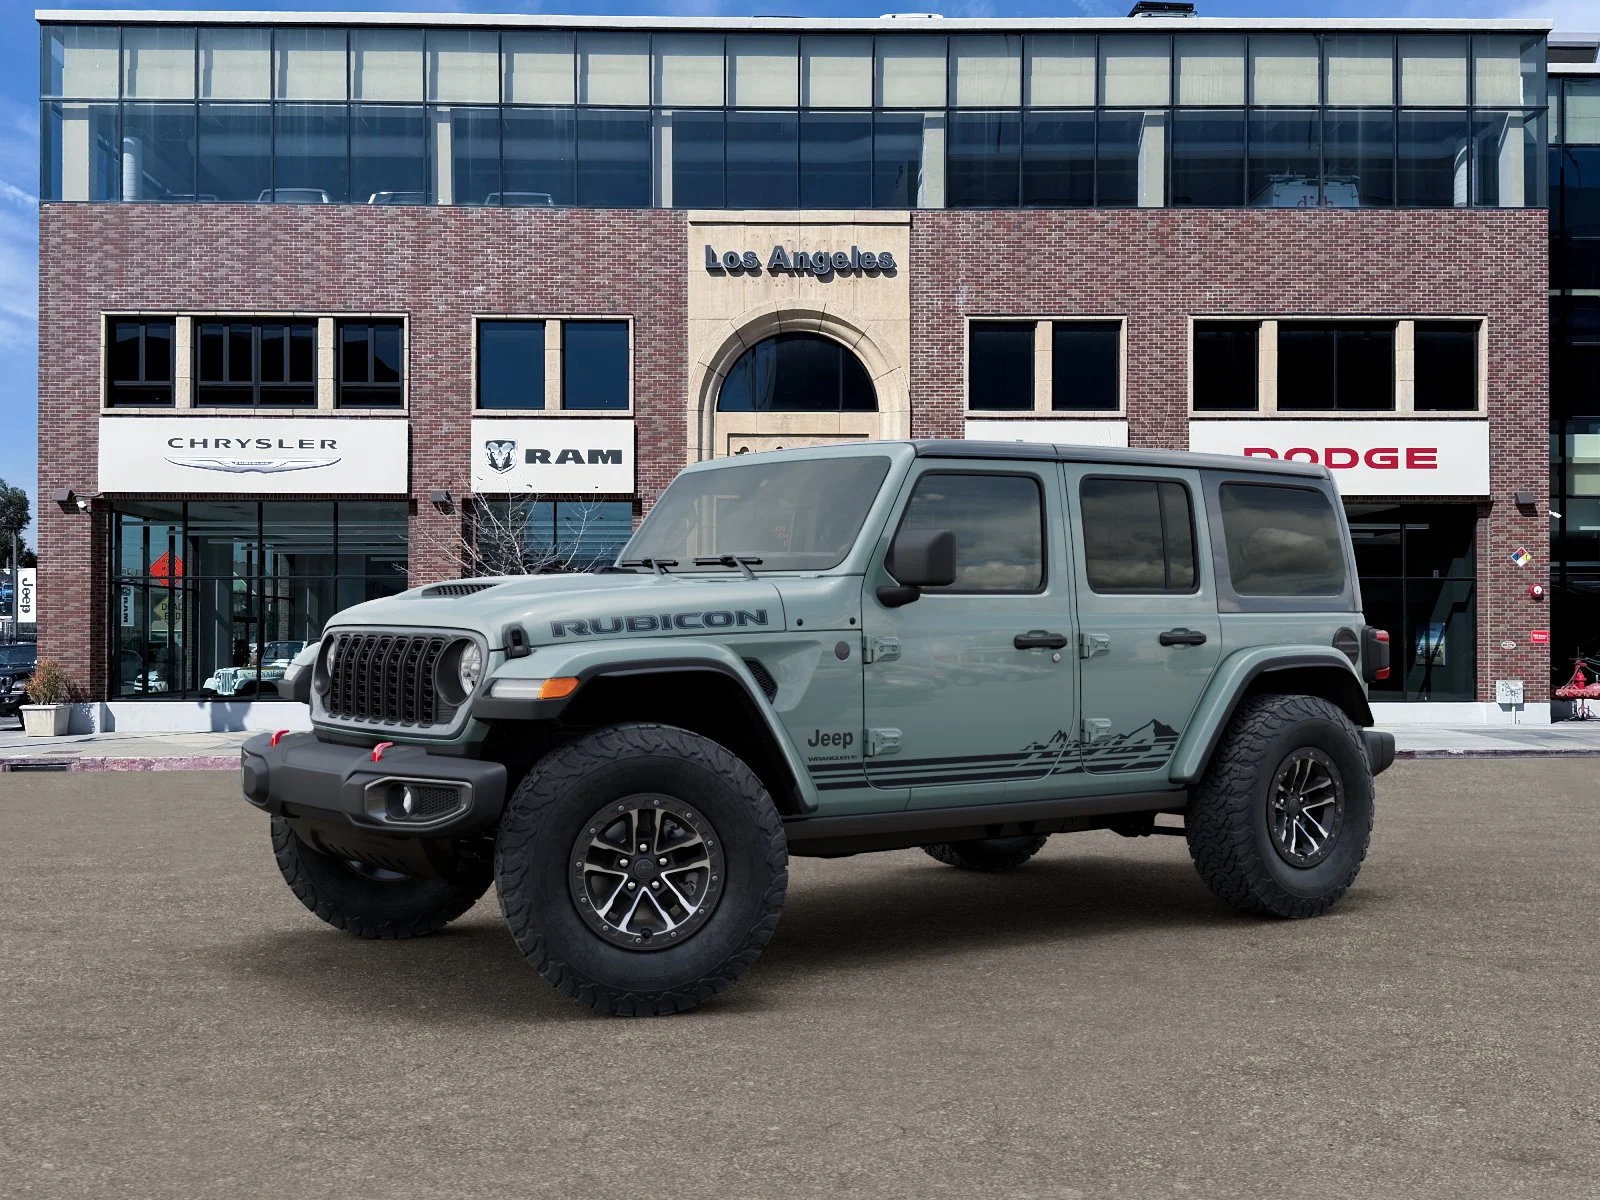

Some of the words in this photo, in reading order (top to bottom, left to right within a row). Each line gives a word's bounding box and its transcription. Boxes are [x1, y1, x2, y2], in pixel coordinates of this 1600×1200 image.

[705, 244, 759, 269] Los
[766, 245, 895, 275] Angeles
[167, 437, 338, 450] CHRYSLER
[525, 448, 622, 464] RAM
[20, 577, 33, 614] Jeep
[550, 609, 769, 638] RUBICON
[807, 729, 854, 749] Jeep
